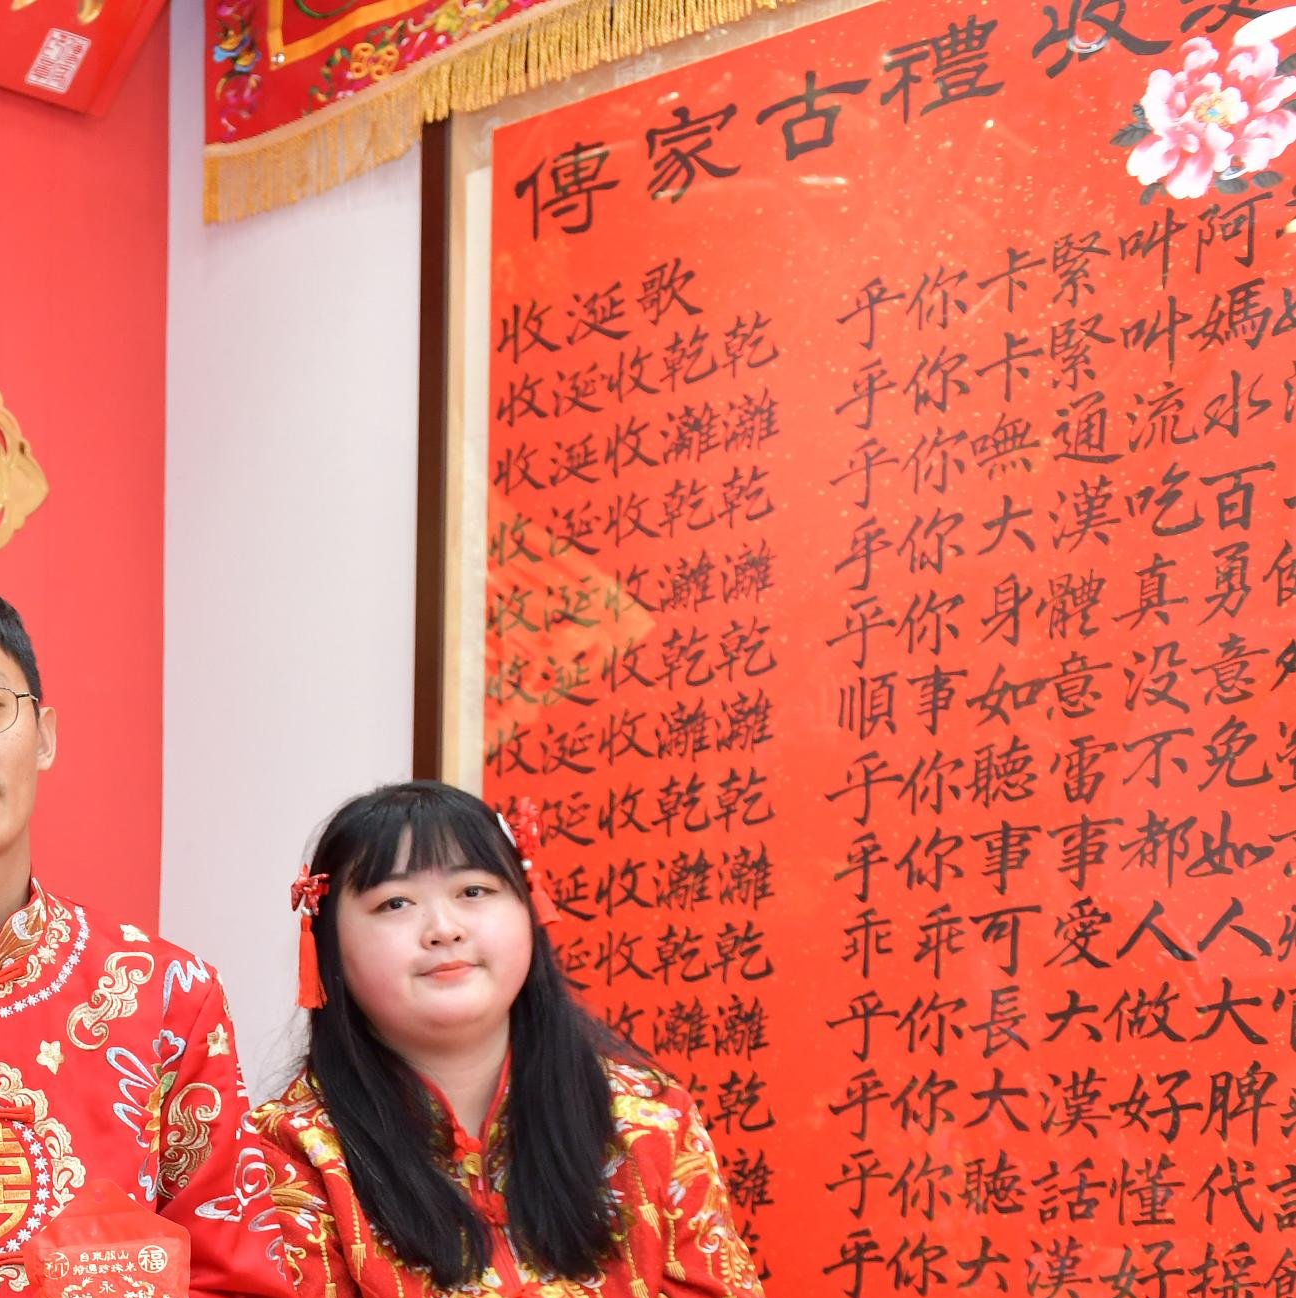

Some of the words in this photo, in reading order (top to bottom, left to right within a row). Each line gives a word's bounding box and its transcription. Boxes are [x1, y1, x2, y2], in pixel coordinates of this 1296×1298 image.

[515, 0, 1263, 241] 傳家古禮收
[497, 257, 703, 364] 收涎歌
[837, 190, 1296, 350] 乎你卡緊叫阿
[496, 311, 779, 427] 收涎收乾乾
[830, 361, 1296, 509] 乎你嘸通流水
[488, 465, 775, 567] 收涎收乾乾
[835, 461, 1296, 591] 乎你大漢吃百
[140, 1248, 166, 1272] 福
